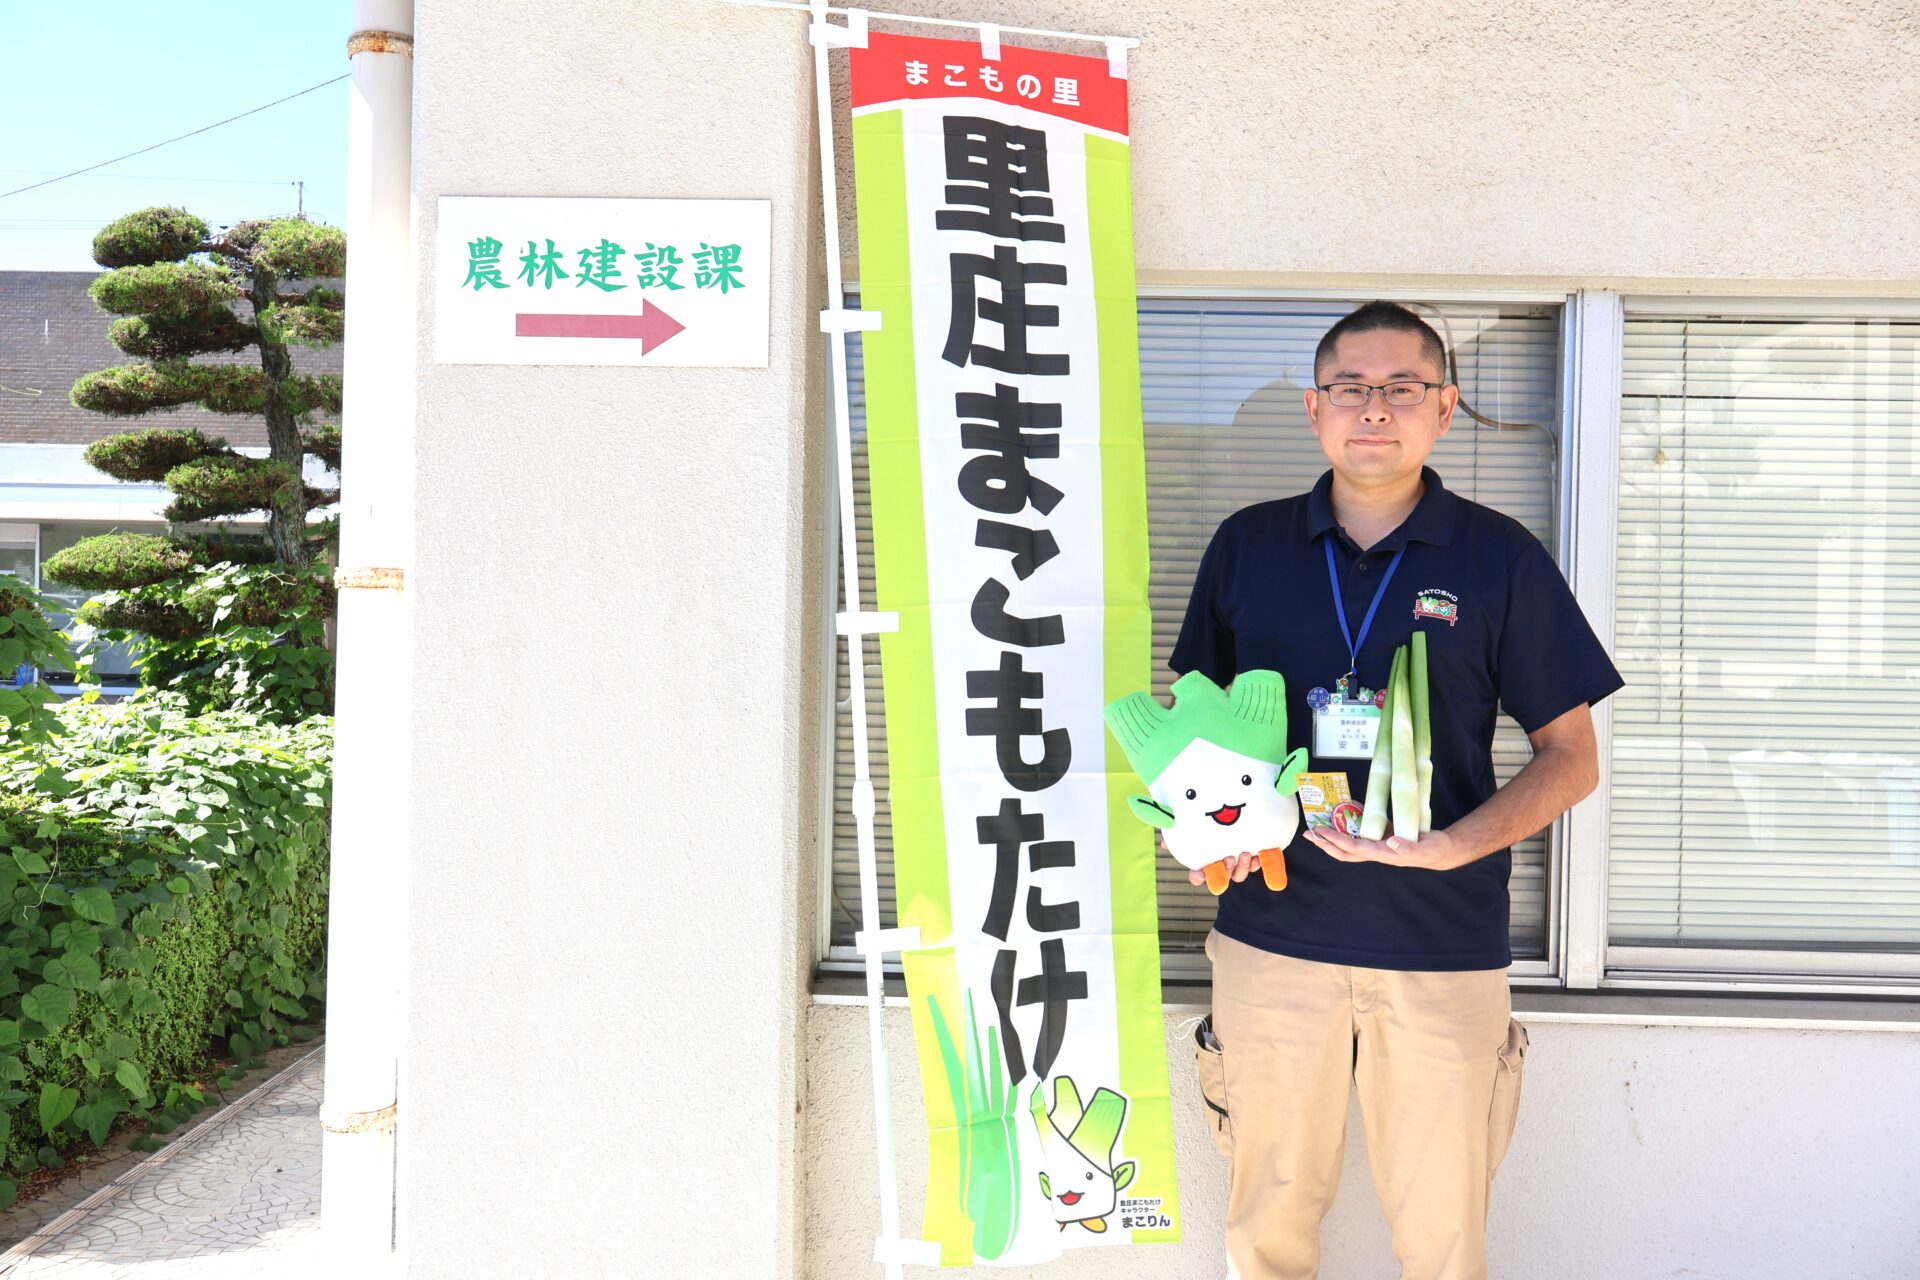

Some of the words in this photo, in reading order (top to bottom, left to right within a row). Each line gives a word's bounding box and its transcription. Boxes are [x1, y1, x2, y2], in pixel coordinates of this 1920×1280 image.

[905, 61, 1080, 107] まこもの里
[462, 236, 746, 295] 農林建設課
[935, 115, 1088, 1087] 里庄まこもたけ
[1417, 588, 1458, 602] SATOSHO
[1122, 1215, 1171, 1229] まこりん
